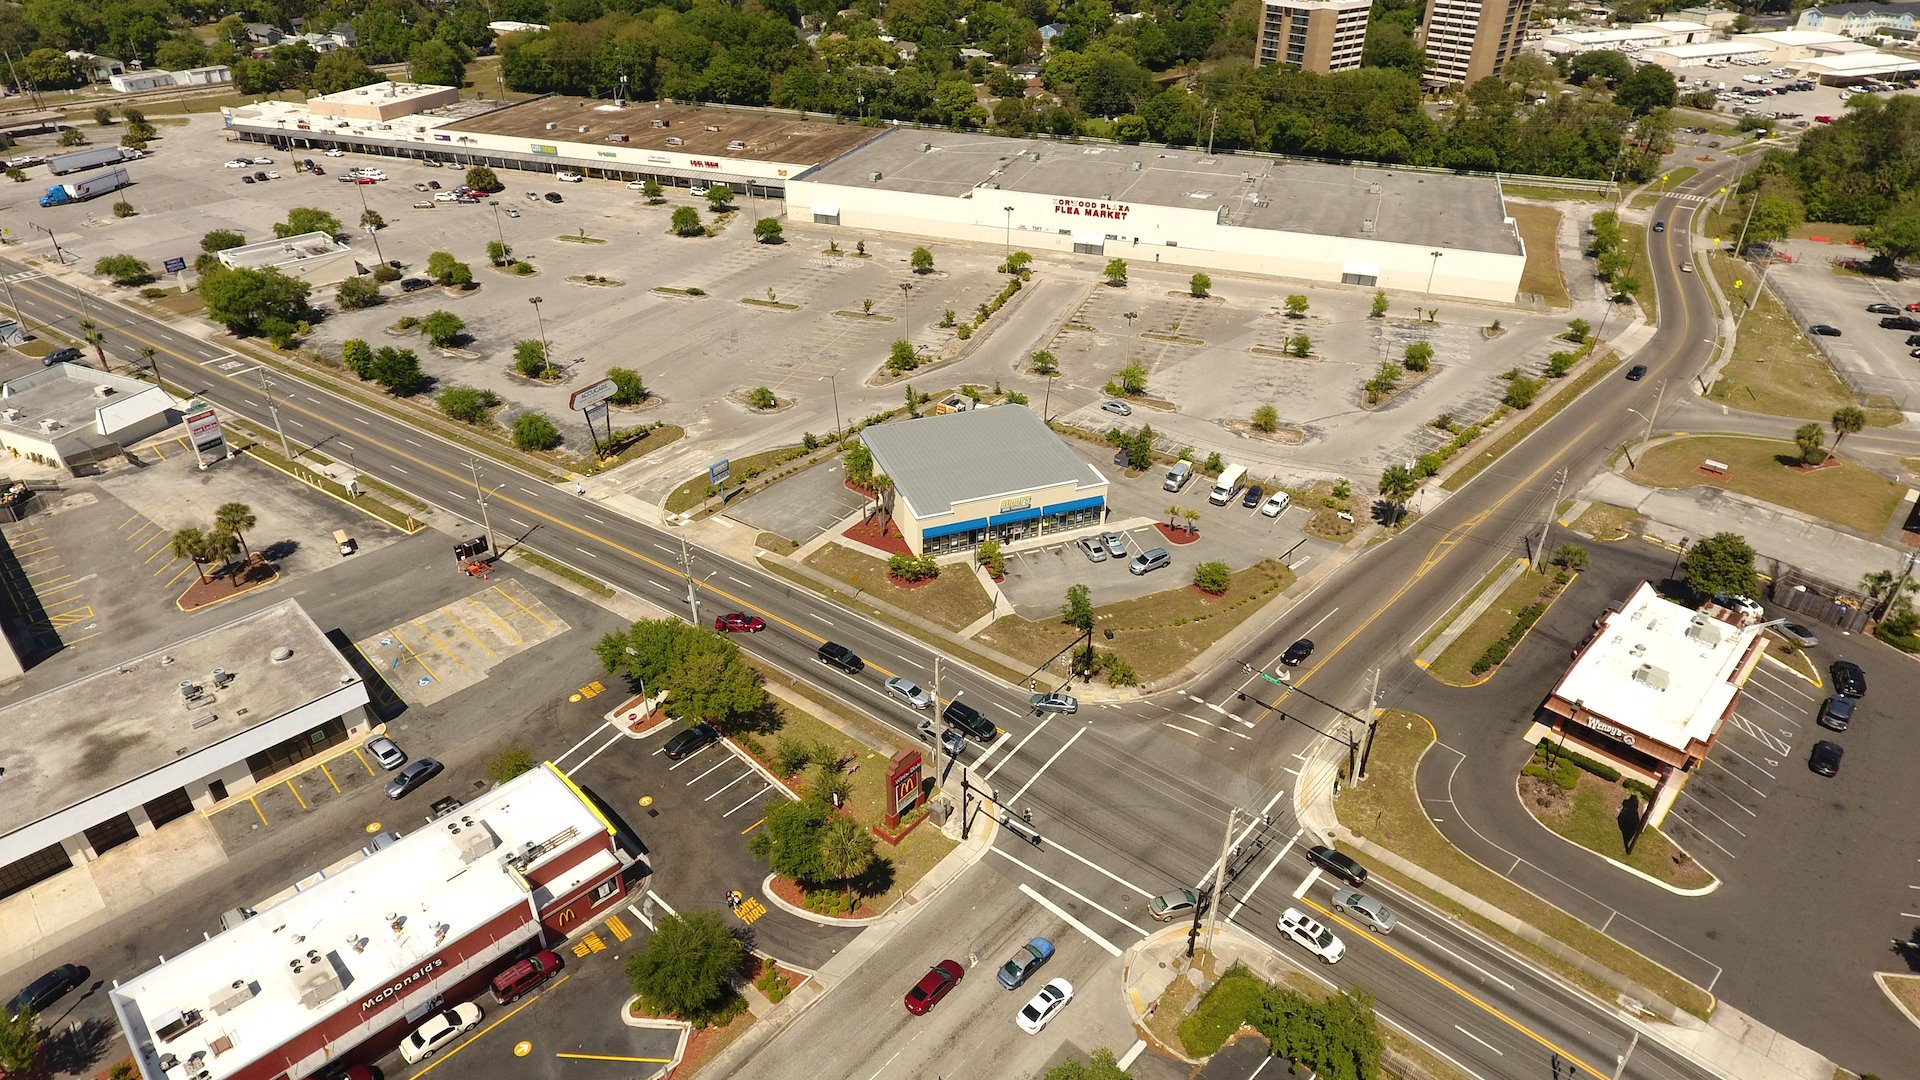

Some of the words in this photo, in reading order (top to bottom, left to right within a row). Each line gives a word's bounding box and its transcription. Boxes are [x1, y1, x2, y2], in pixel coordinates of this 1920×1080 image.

[1053, 199, 1097, 209] OROOD
[1101, 203, 1130, 212] PLZA
[1055, 206, 1080, 216] FLEA
[1085, 208, 1127, 220] MARKET
[741, 903, 767, 926] THRU
[361, 958, 443, 1012] McDonald's
